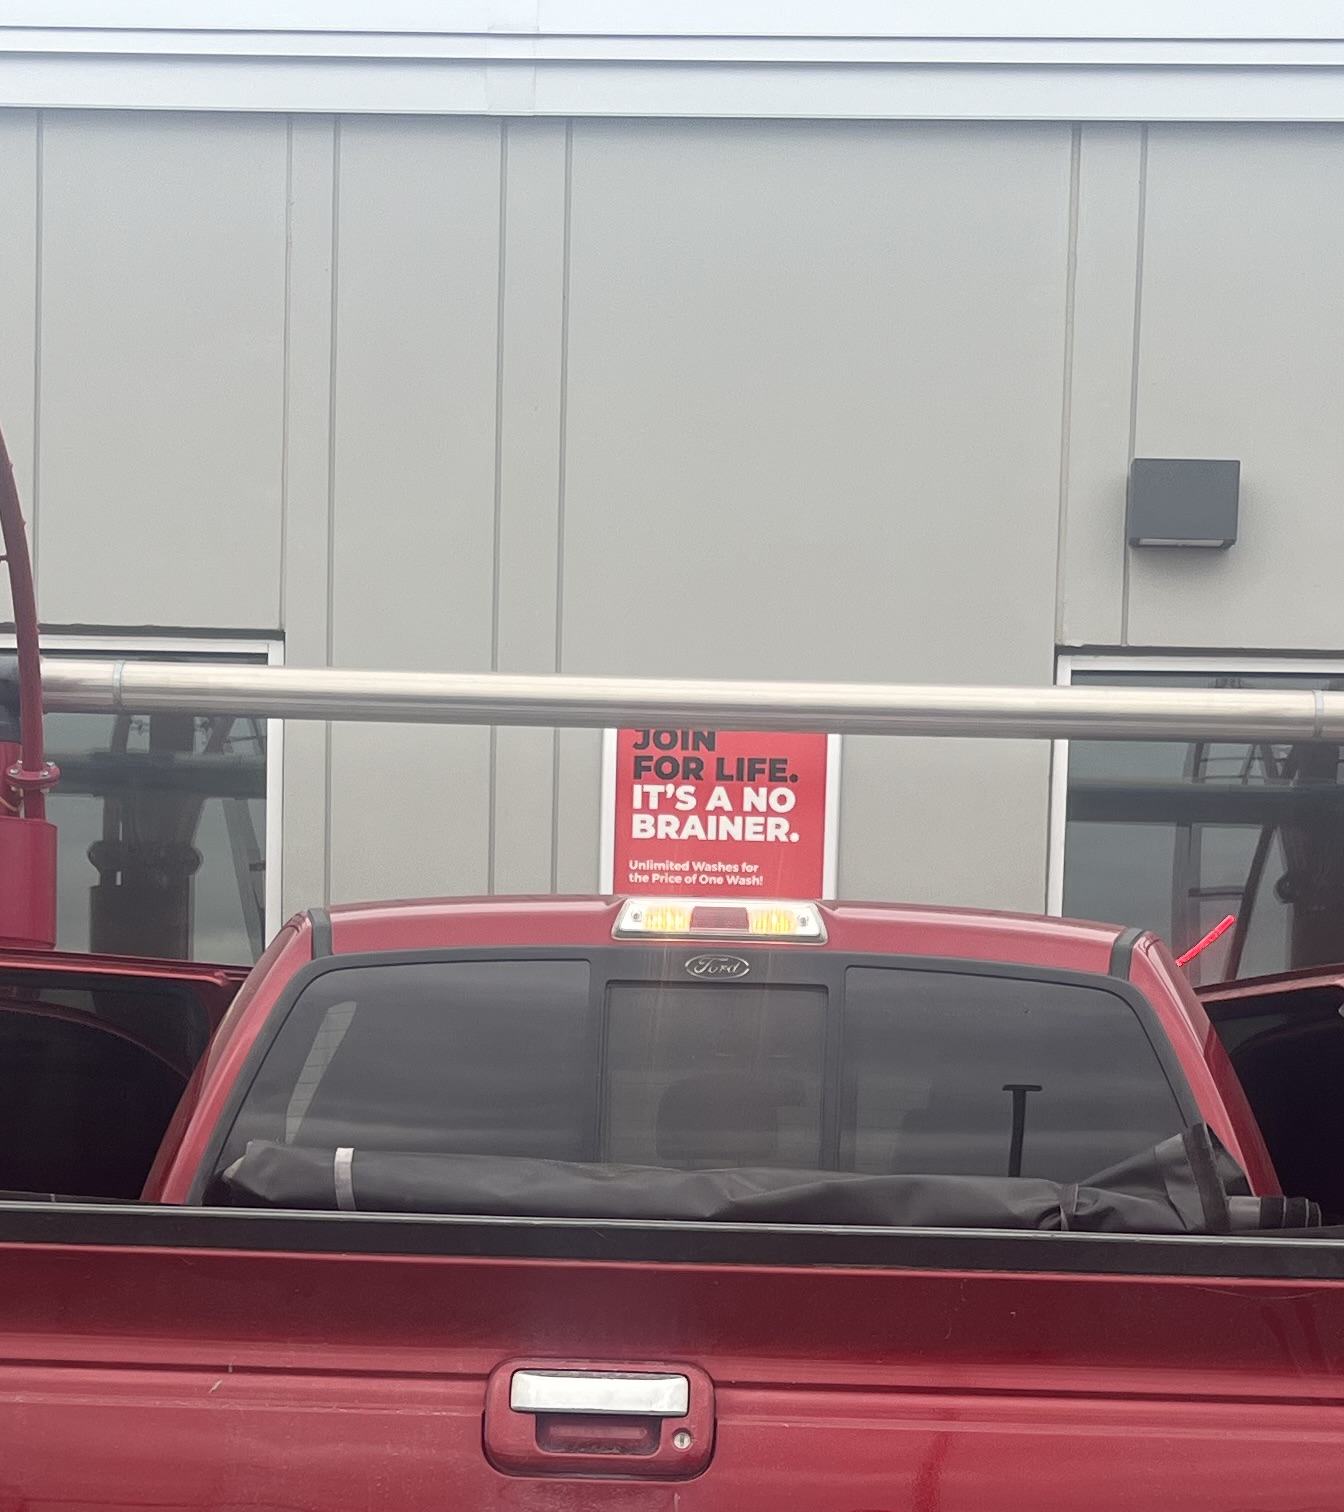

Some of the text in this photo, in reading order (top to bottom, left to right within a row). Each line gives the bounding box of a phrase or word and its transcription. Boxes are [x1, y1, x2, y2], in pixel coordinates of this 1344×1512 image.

[633, 729, 715, 751] JOIN
[633, 756, 798, 783] FOR LIFE.
[632, 784, 796, 813] IT'S A NO
[631, 813, 800, 843] BRAINER.
[629, 860, 759, 873] Unlimited Washes for
[629, 873, 764, 886] the Price of One Wash!
